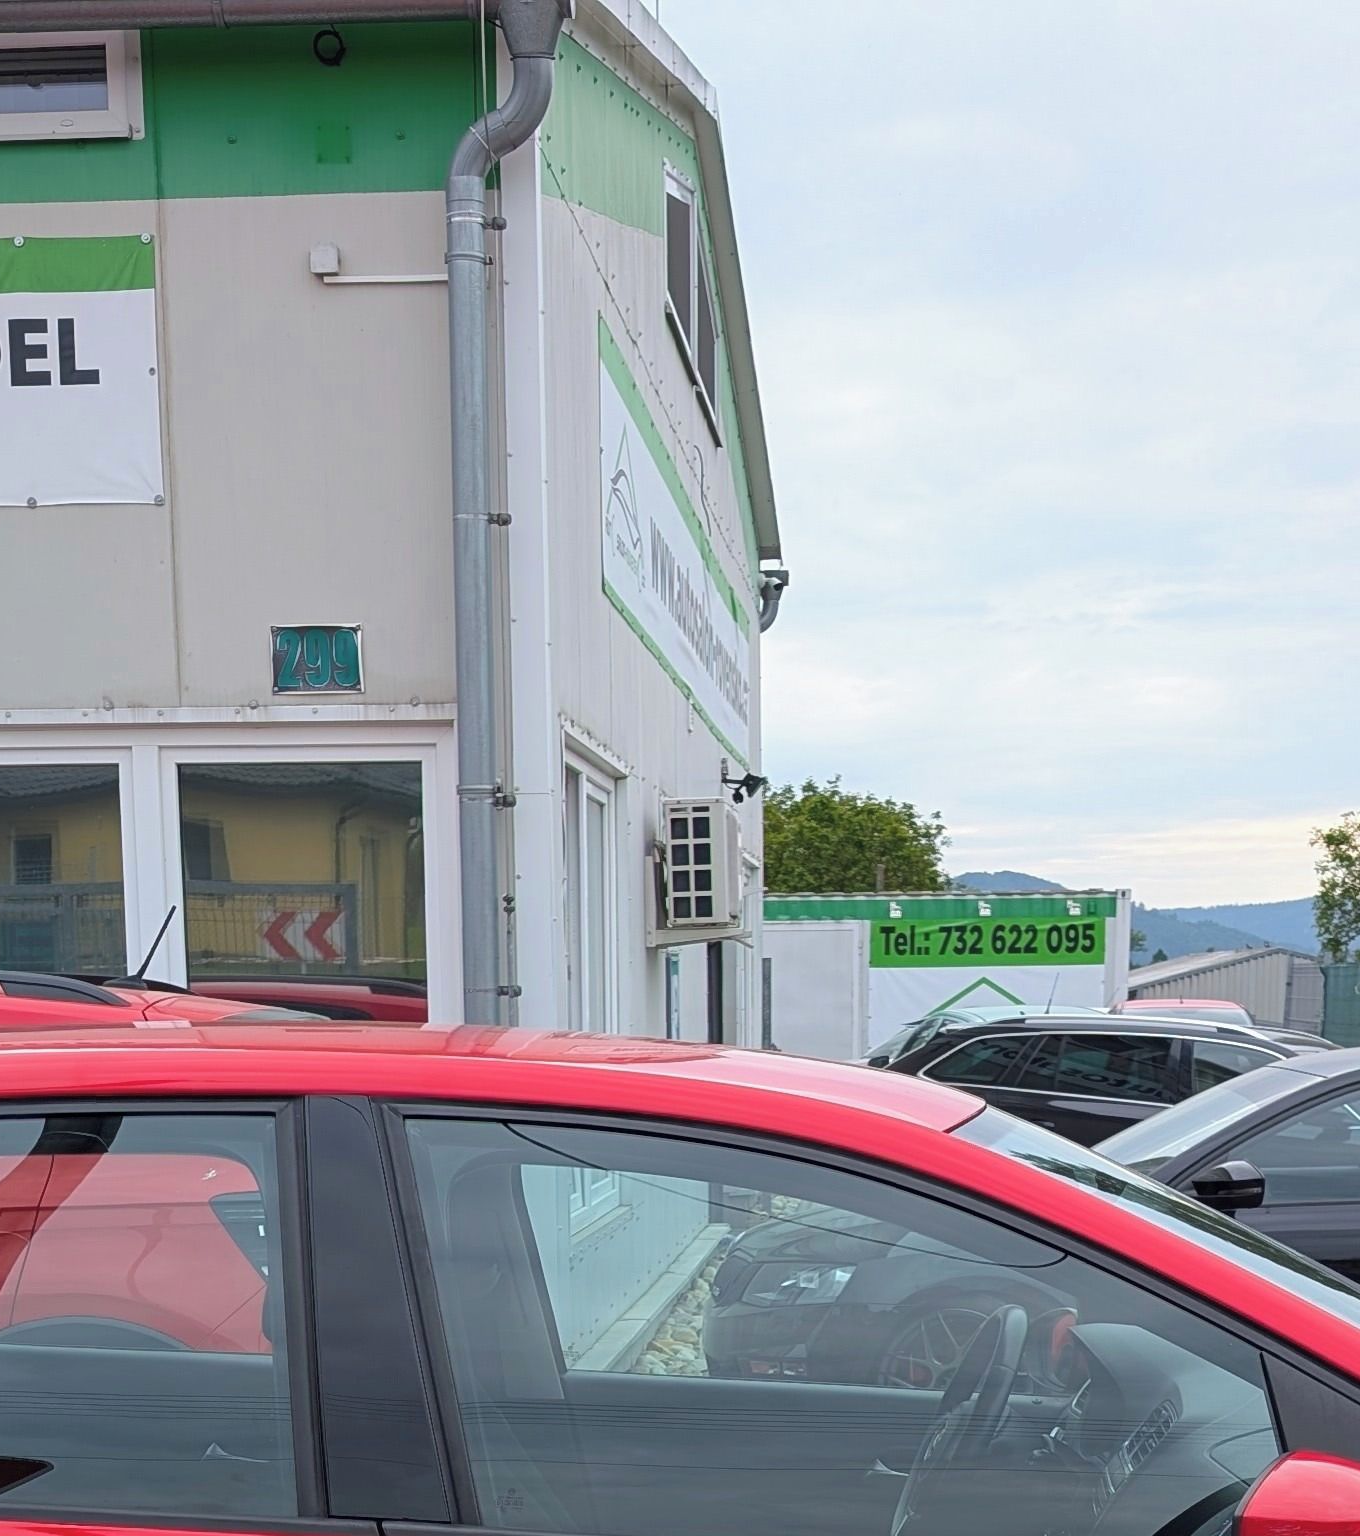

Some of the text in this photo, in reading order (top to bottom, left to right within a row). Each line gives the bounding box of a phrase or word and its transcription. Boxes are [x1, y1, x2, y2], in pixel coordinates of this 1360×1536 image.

[276, 628, 360, 688] 299
[879, 923, 1096, 956] Tel.: 732 622 095
